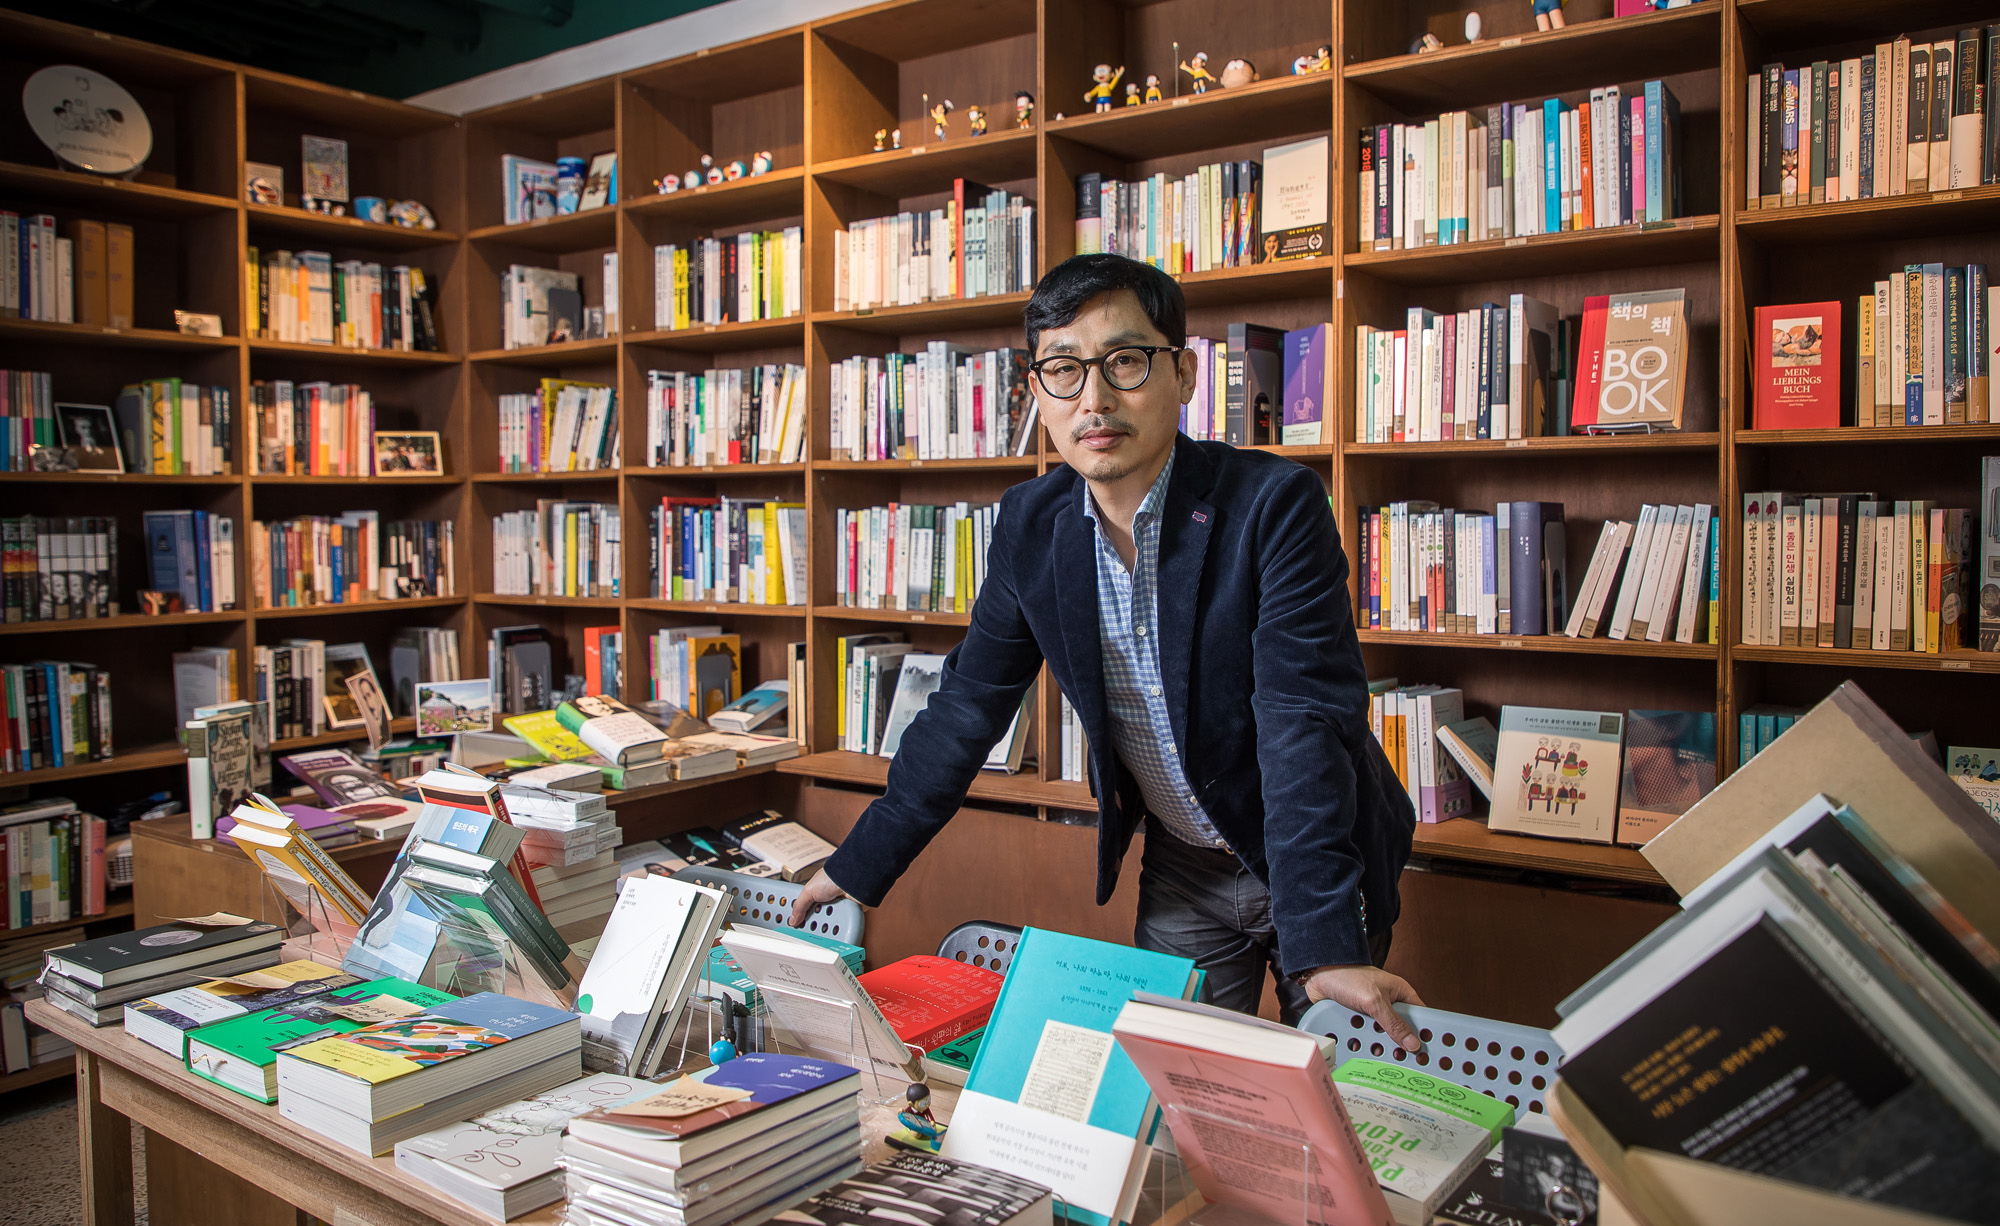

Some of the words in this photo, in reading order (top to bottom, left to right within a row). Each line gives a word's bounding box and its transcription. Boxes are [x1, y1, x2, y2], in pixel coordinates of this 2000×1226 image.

[1814, 70, 1823, 103] 레플리카
[1362, 147, 1371, 171] 2018
[1581, 139, 1589, 165] SHIFT
[1612, 302, 1647, 321] 책의
[1650, 316, 1672, 337] 책
[1910, 312, 1919, 344] 정치적인
[1603, 346, 1668, 382] BO
[1910, 346, 1919, 369] 음식들
[1773, 376, 1822, 386] LIEBLINGS
[1785, 368, 1810, 376] MEIN
[1600, 379, 1670, 415] OK
[1783, 385, 1810, 394] BUCH
[1785, 531, 1795, 552] 좋은
[1785, 554, 1795, 574] 인생
[1785, 576, 1795, 605] 실험실
[1347, 1114, 1422, 1152] PEOP
